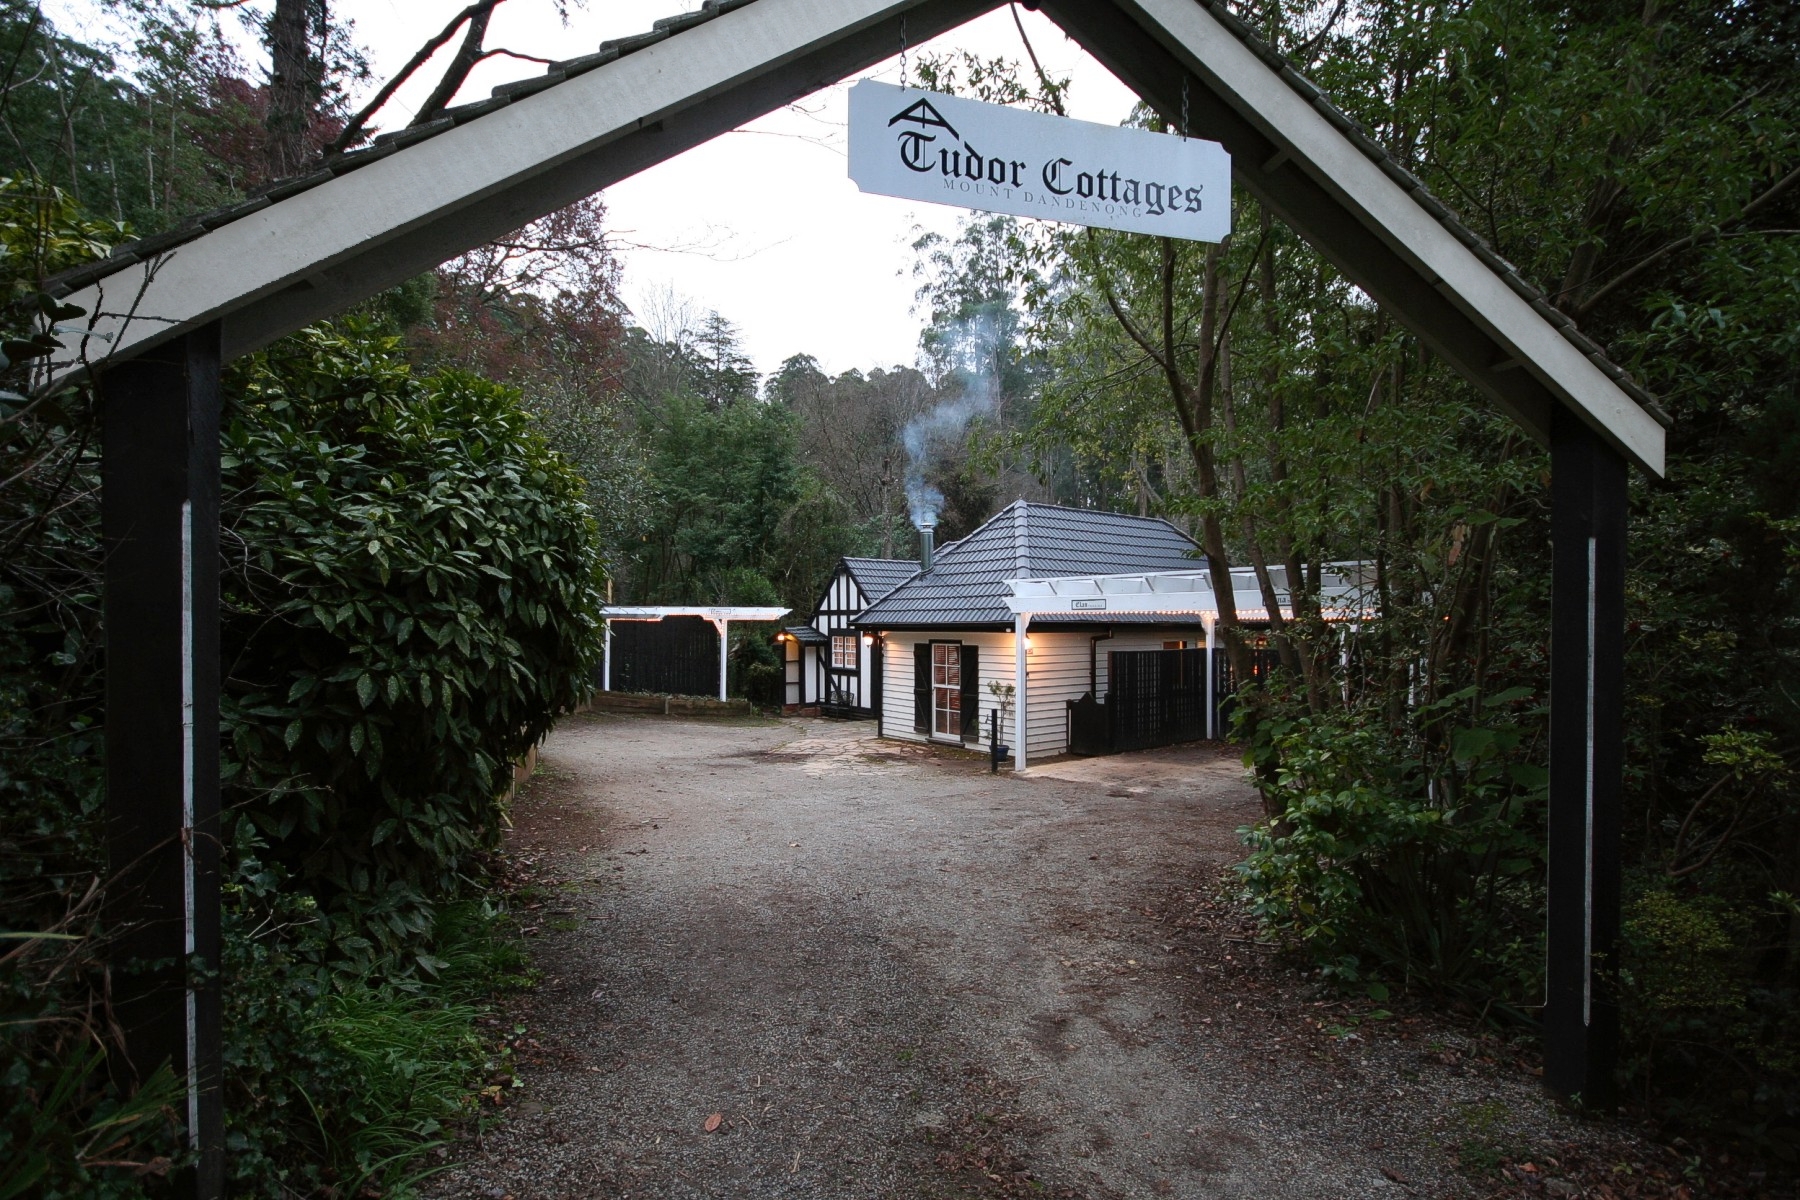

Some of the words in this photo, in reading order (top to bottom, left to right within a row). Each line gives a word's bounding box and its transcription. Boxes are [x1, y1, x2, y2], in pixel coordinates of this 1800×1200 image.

[898, 131, 1027, 188] Tudor
[1042, 157, 1203, 216] Cottages
[943, 178, 1013, 199] MOUNT
[1024, 191, 1142, 218] DANDENONG
